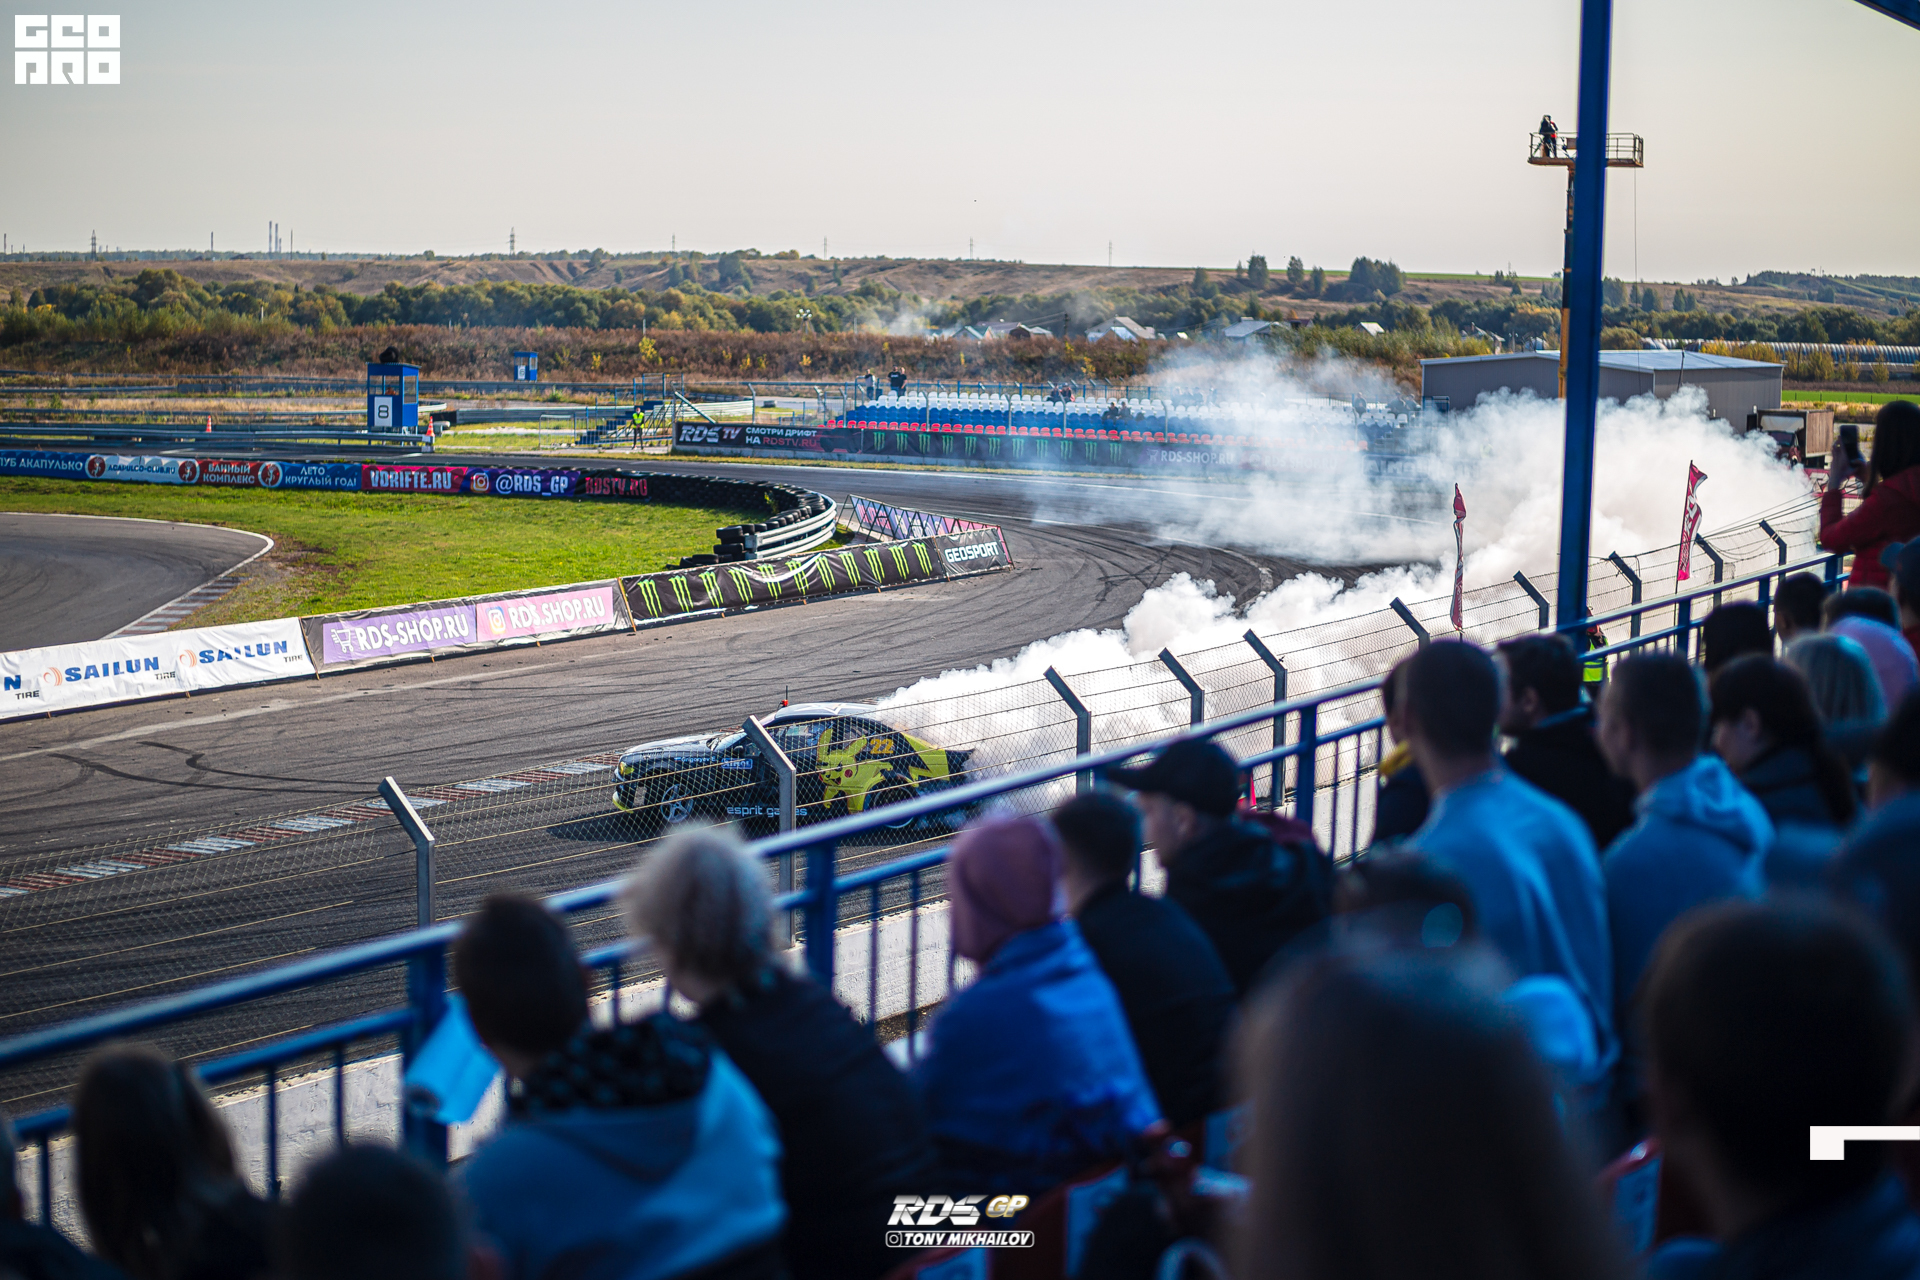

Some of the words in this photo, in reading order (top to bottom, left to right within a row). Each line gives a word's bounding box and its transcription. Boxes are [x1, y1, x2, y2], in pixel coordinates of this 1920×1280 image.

[377, 404, 389, 419] 8
[679, 425, 722, 443] RDS
[722, 427, 742, 440] TV
[745, 426, 784, 436] СМОТРИ
[784, 428, 817, 437] ДРИФТ
[745, 435, 761, 444] НА
[763, 437, 817, 447] RDSTV.RU
[19, 458, 84, 471] АКАПУЛЬКО
[1160, 449, 1235, 465] RDS-SHOP.RU
[1264, 454, 1337, 469] RDSSHOP.RU
[208, 462, 251, 474] БАННЫЙ
[300, 466, 326, 476] ЛЕТО
[202, 473, 255, 485] КОМПЛЕКС
[285, 475, 332, 486] КРУГЛЫЙ
[370, 469, 452, 490] VDRIFTE.RU
[495, 473, 569, 497] @RDS_GP
[585, 477, 648, 496] RDSTV.RU
[944, 541, 1000, 563] GEOSPORT
[509, 595, 606, 629] RDS.SHOP.RU
[356, 613, 469, 651] RDS-SHOP.RU
[198, 640, 288, 664] SAILUN
[283, 654, 303, 663] TIRE
[65, 656, 160, 682] SAILUN
[154, 671, 176, 680] TIRE
[15, 690, 40, 700] TIRE
[869, 738, 894, 755] 22
[726, 805, 763, 817] esprit
